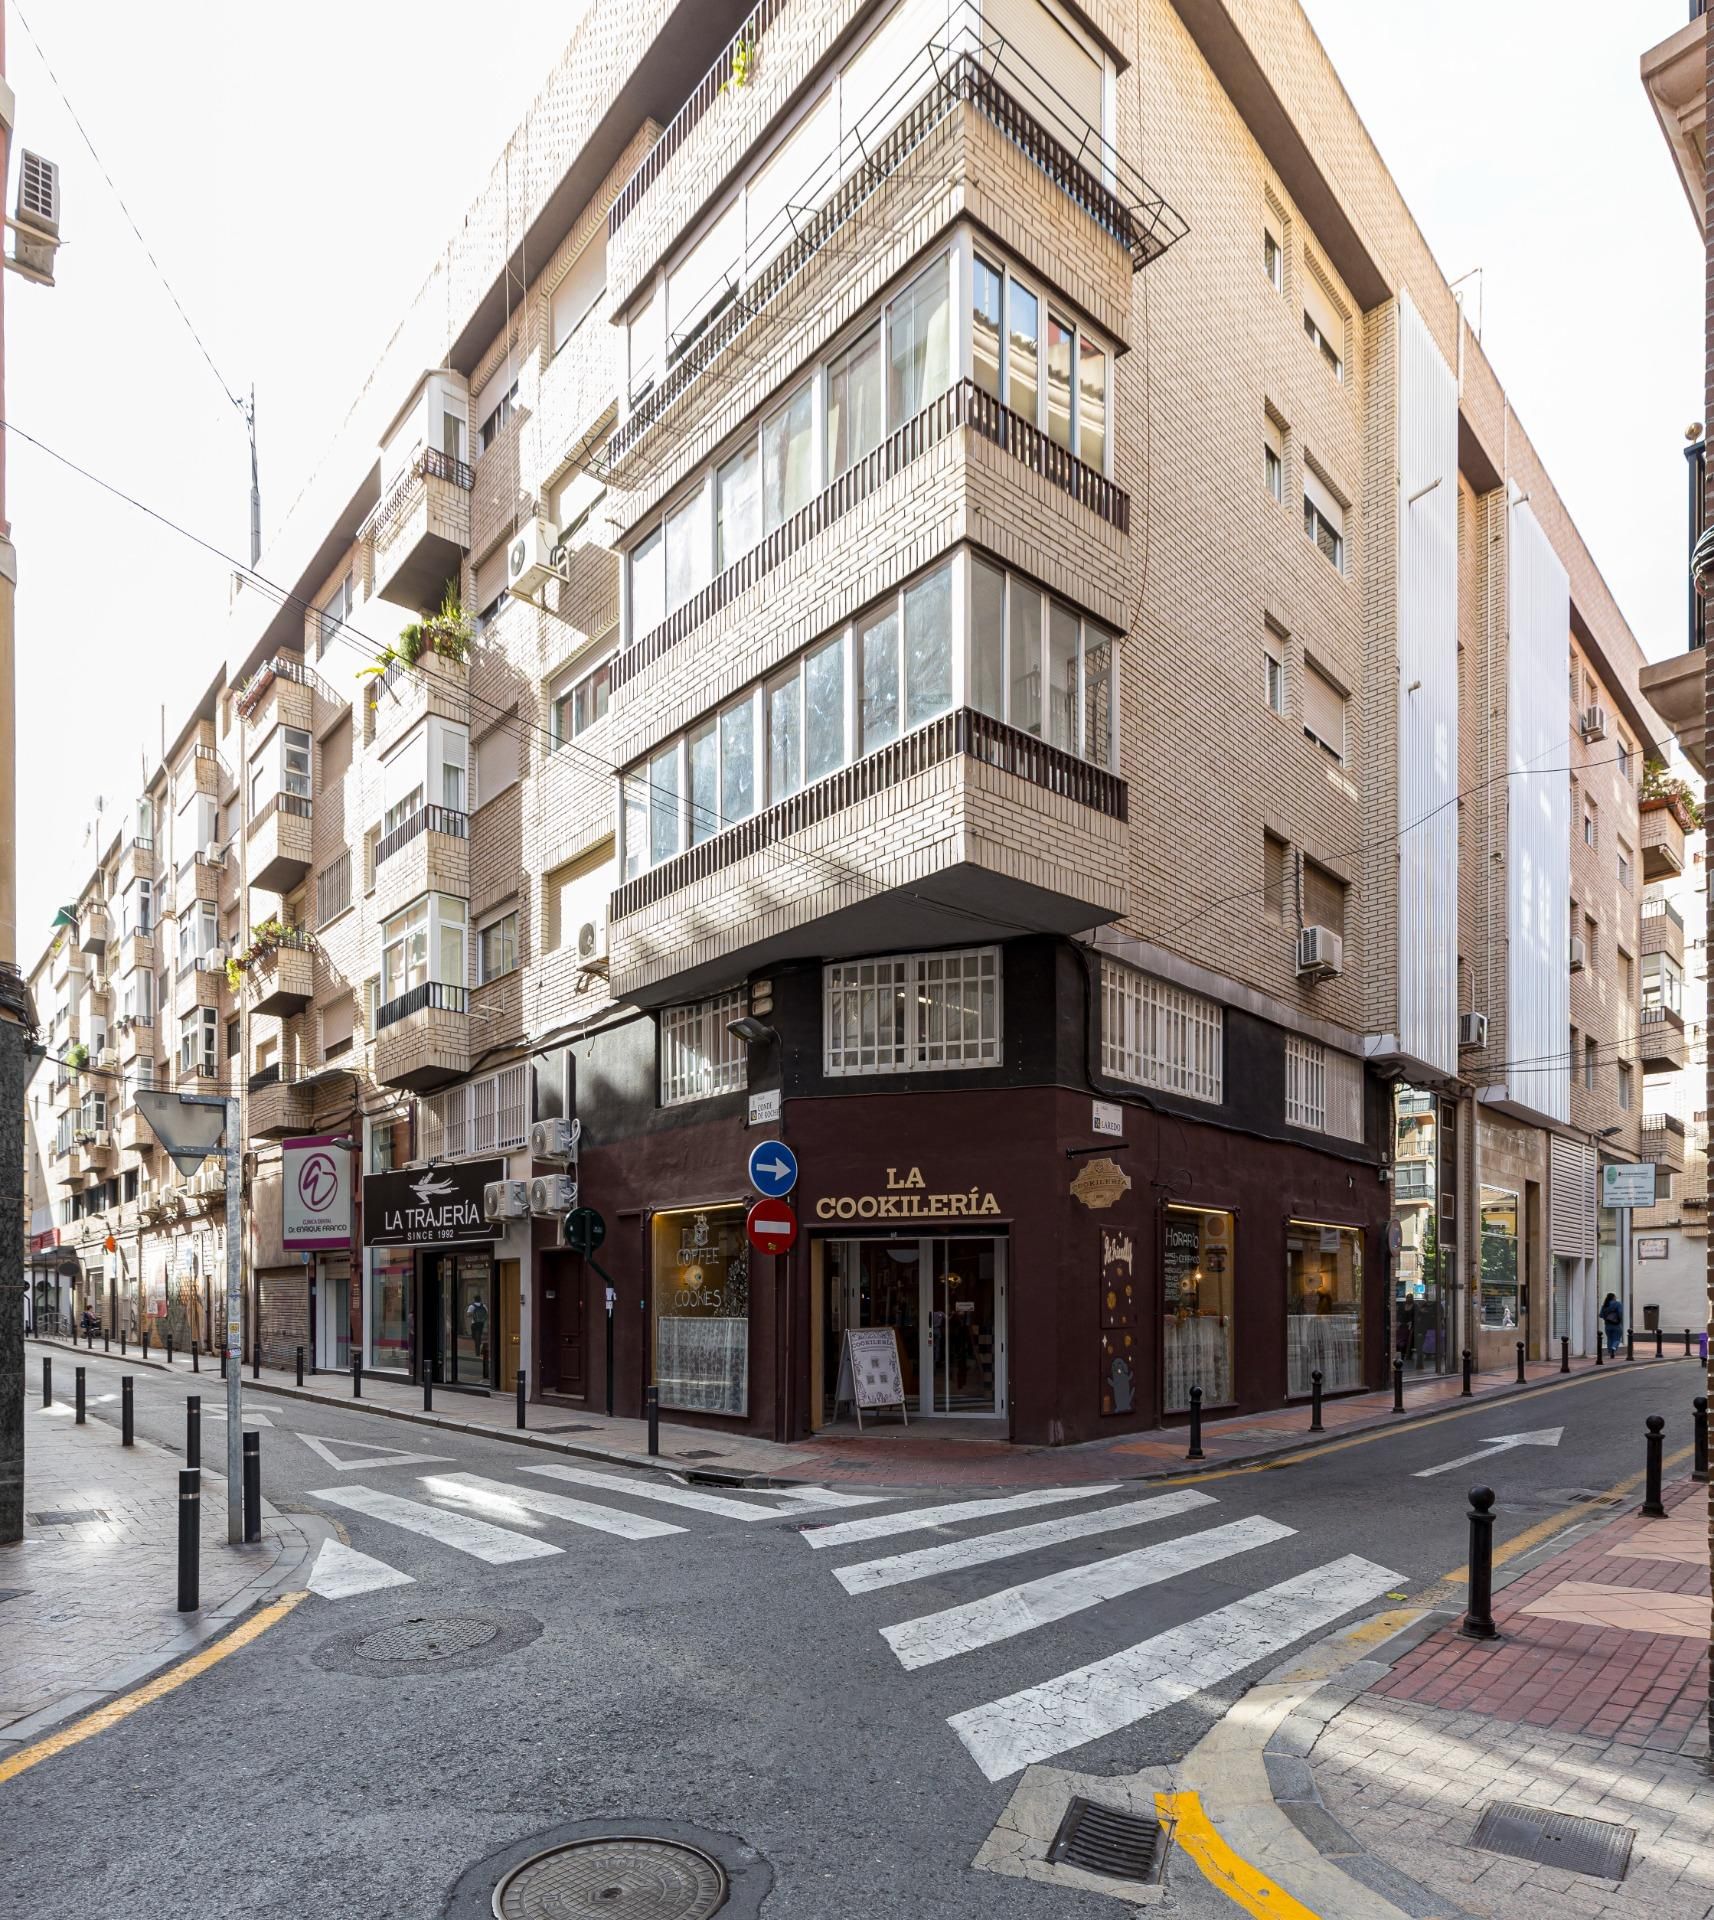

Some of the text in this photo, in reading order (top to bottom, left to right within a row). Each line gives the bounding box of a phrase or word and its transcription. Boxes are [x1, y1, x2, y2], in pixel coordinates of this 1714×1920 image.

[1101, 1120, 1121, 1132] LAREDO
[886, 1166, 926, 1189] LA
[816, 1186, 1001, 1219] COOKILERÍA
[385, 1199, 480, 1230] LA TRAJERÍA
[407, 1229, 454, 1241] SINCE 1992
[676, 1248, 720, 1266] COFFEE
[674, 1285, 722, 1307] COOKIES
